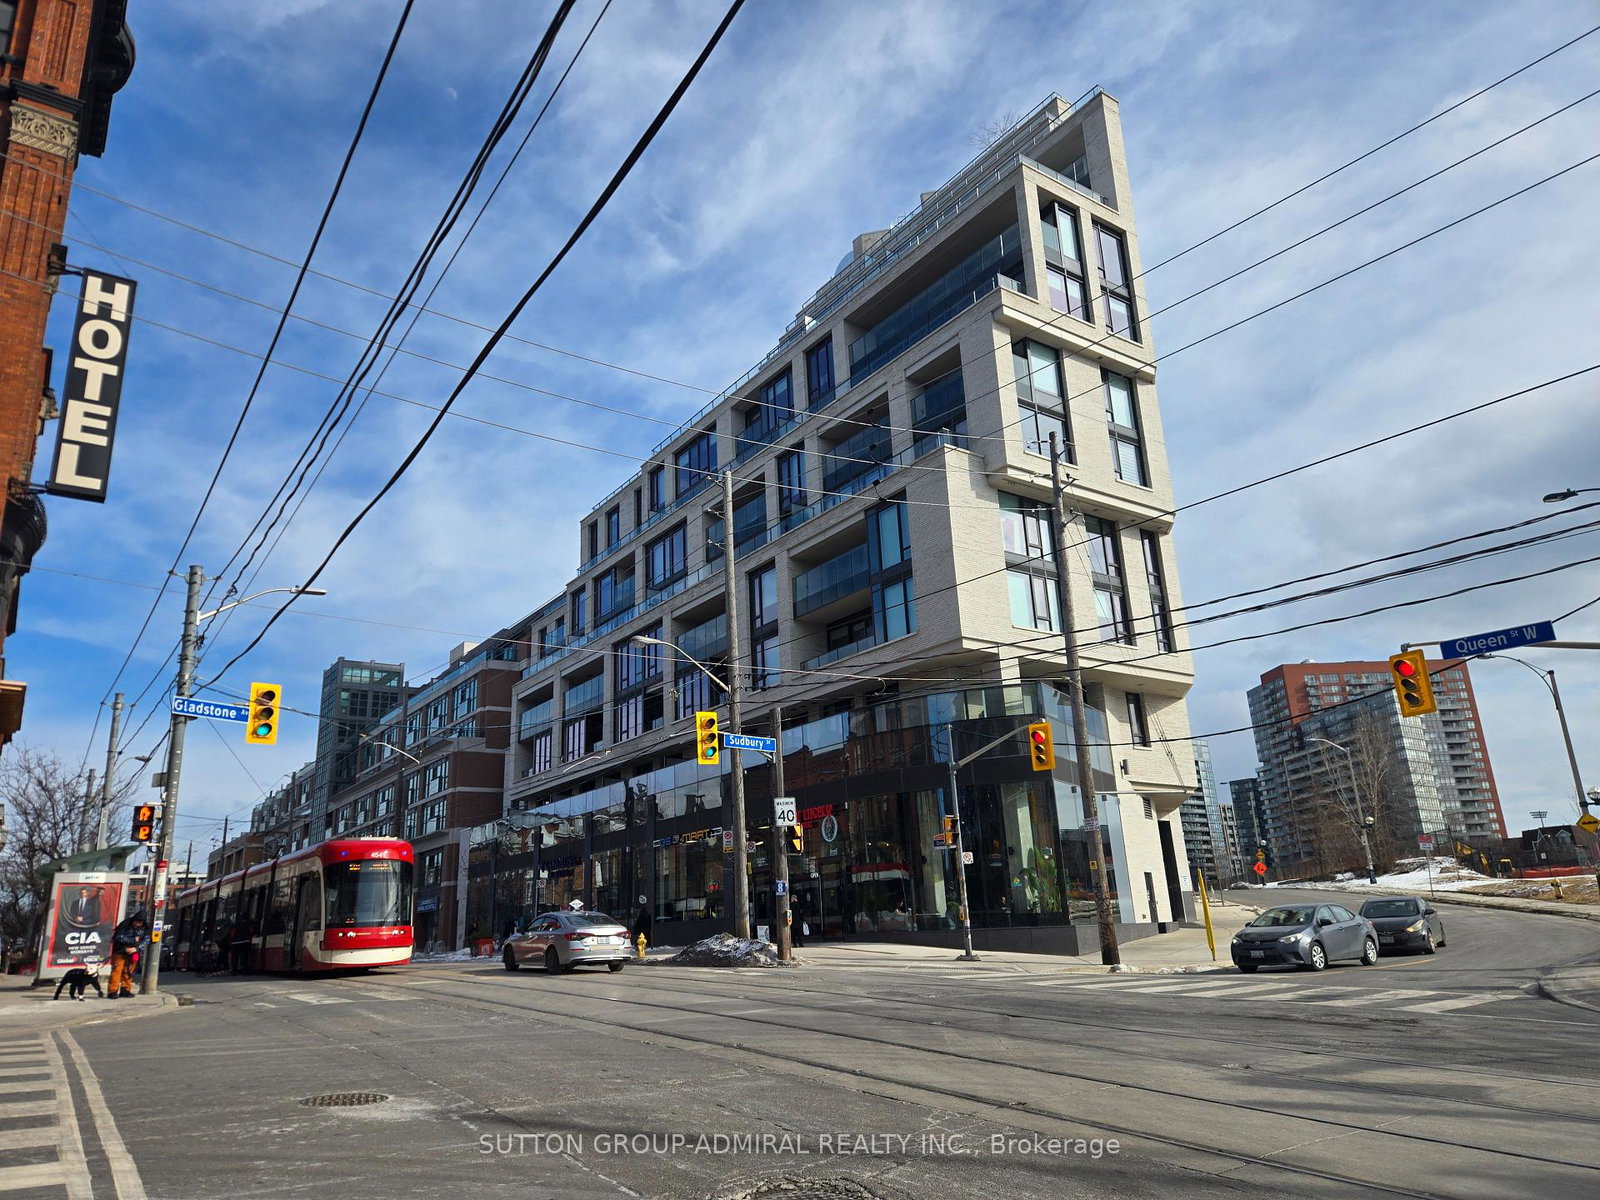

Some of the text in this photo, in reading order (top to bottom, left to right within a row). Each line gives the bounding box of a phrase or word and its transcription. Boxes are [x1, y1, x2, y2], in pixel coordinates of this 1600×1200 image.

[55, 275, 130, 490] HOTEL
[1455, 626, 1537, 654] Queen St W
[174, 699, 237, 718] Gladstone
[729, 735, 764, 749] Sudbury
[778, 809, 795, 822] 40
[777, 883, 783, 893] 8
[64, 931, 102, 945] CIA
